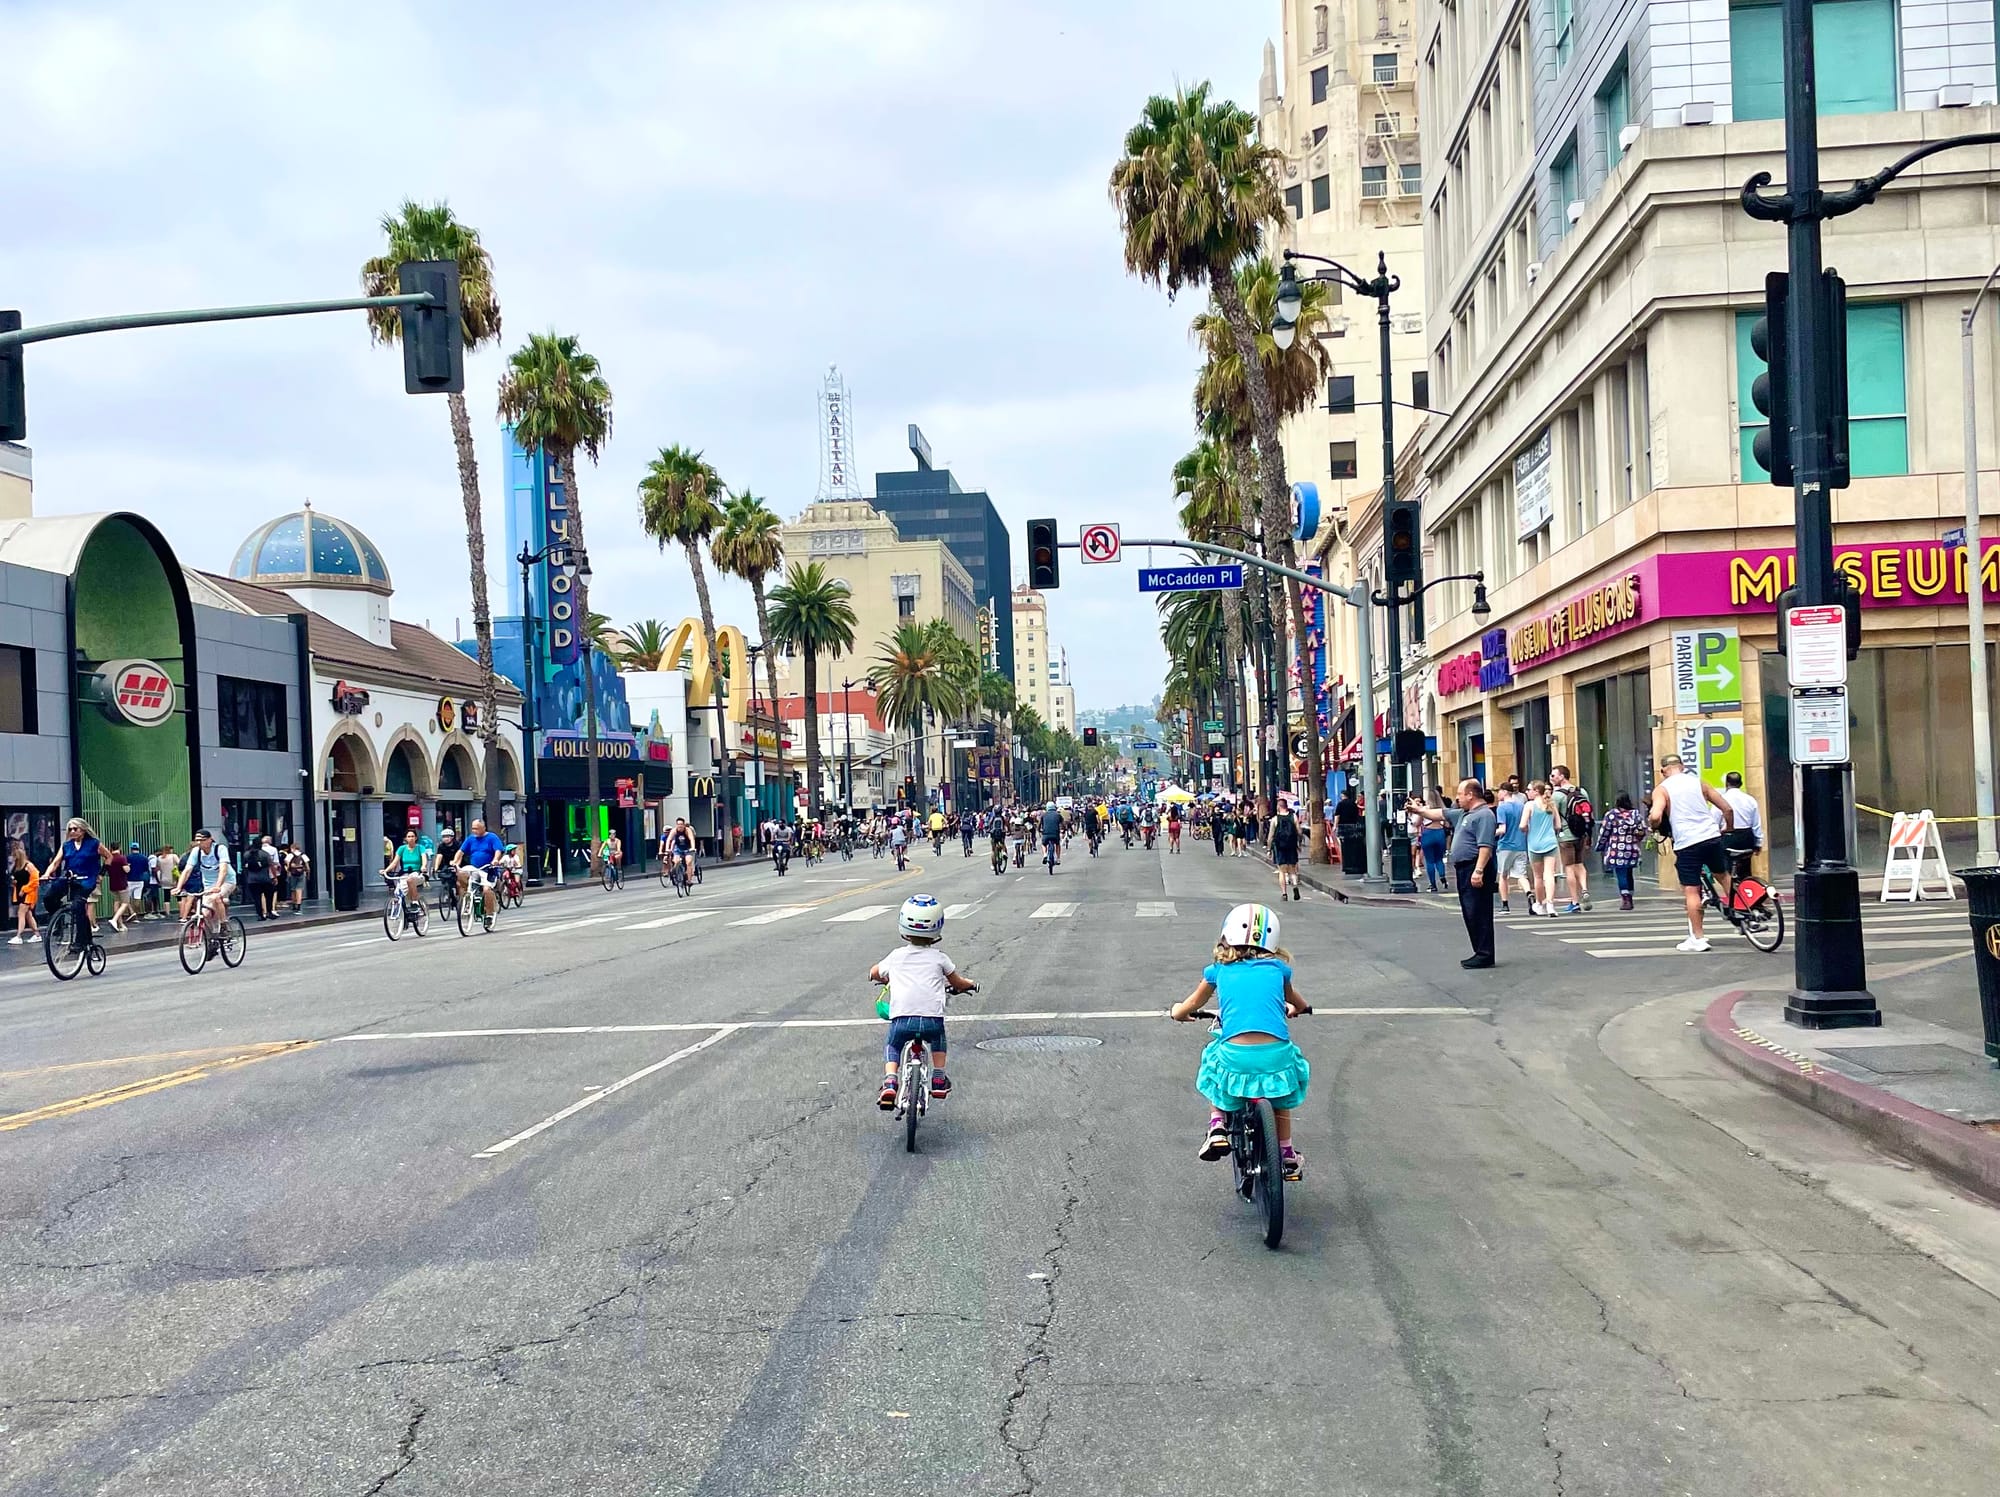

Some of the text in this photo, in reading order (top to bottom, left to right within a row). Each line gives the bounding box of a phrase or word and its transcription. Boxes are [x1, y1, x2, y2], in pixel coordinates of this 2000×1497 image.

[1148, 571, 1233, 587] McCadden Pl
[1510, 616, 1552, 666] MUSEUM
[1551, 606, 1569, 648] OF
[1568, 573, 1641, 641] ILLUSIONS
[1676, 635, 1694, 691] PARKING
[1698, 632, 1727, 667] P
[1703, 725, 1732, 769] P
